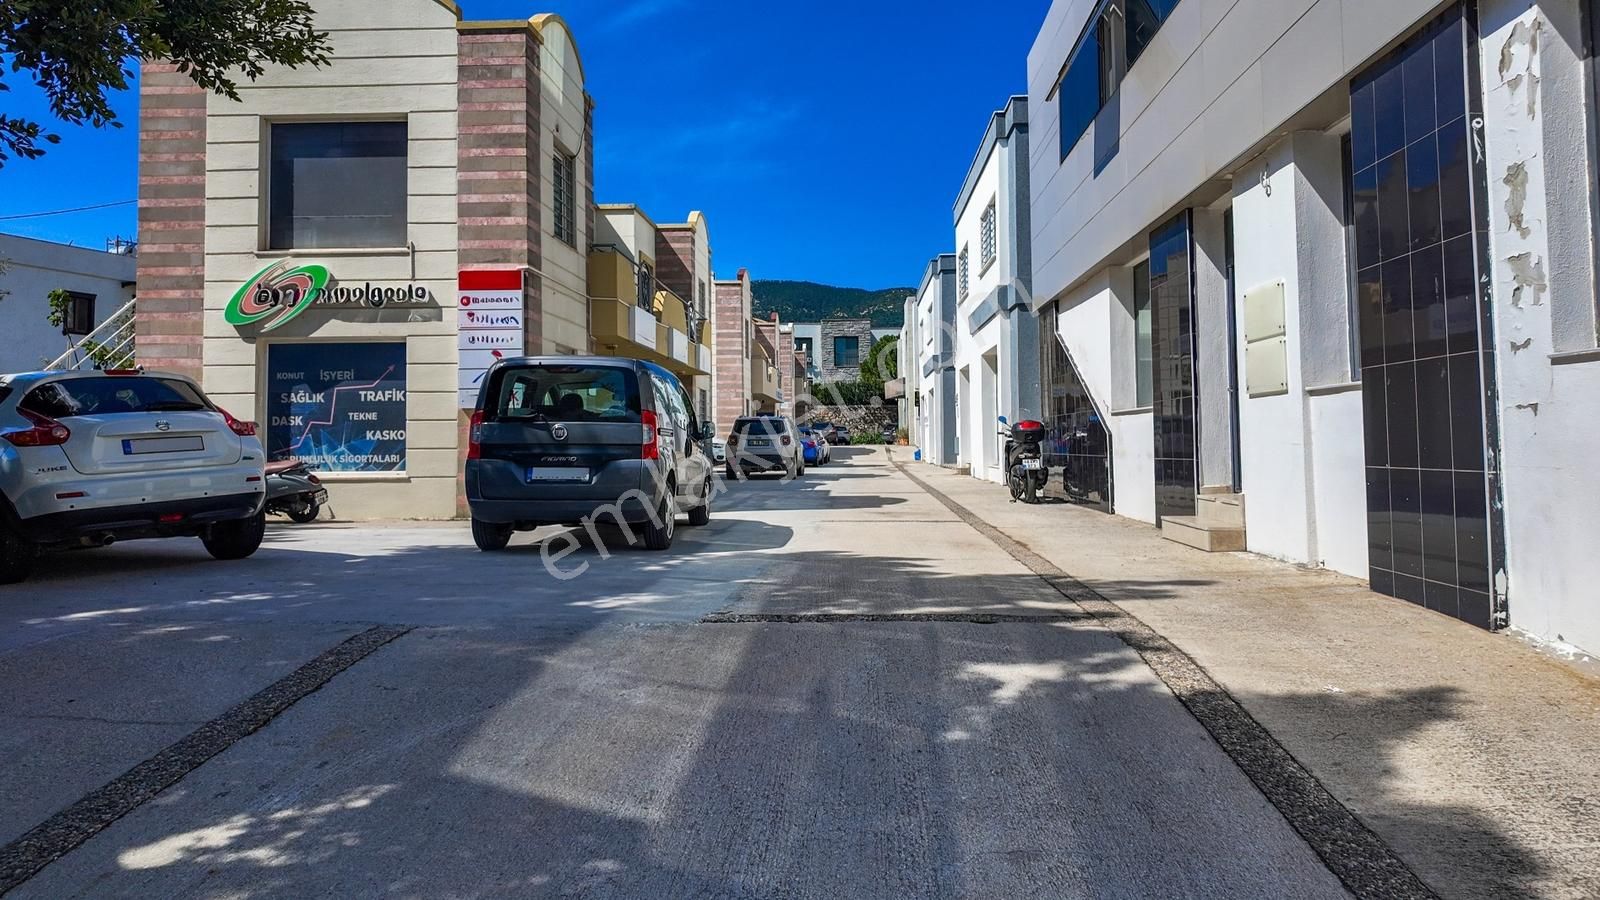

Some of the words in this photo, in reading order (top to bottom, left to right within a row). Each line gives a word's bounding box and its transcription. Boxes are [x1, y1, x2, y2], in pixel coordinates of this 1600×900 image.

[277, 372, 304, 380] KONUT
[320, 369, 354, 381] İŞYERİ
[281, 391, 325, 403] SAĞLIK
[359, 388, 405, 402] TRAFİK
[272, 416, 303, 426] DASK
[348, 412, 377, 420] TEKNE
[366, 430, 405, 440] KASKO
[340, 454, 399, 463] SİGORTALARI
